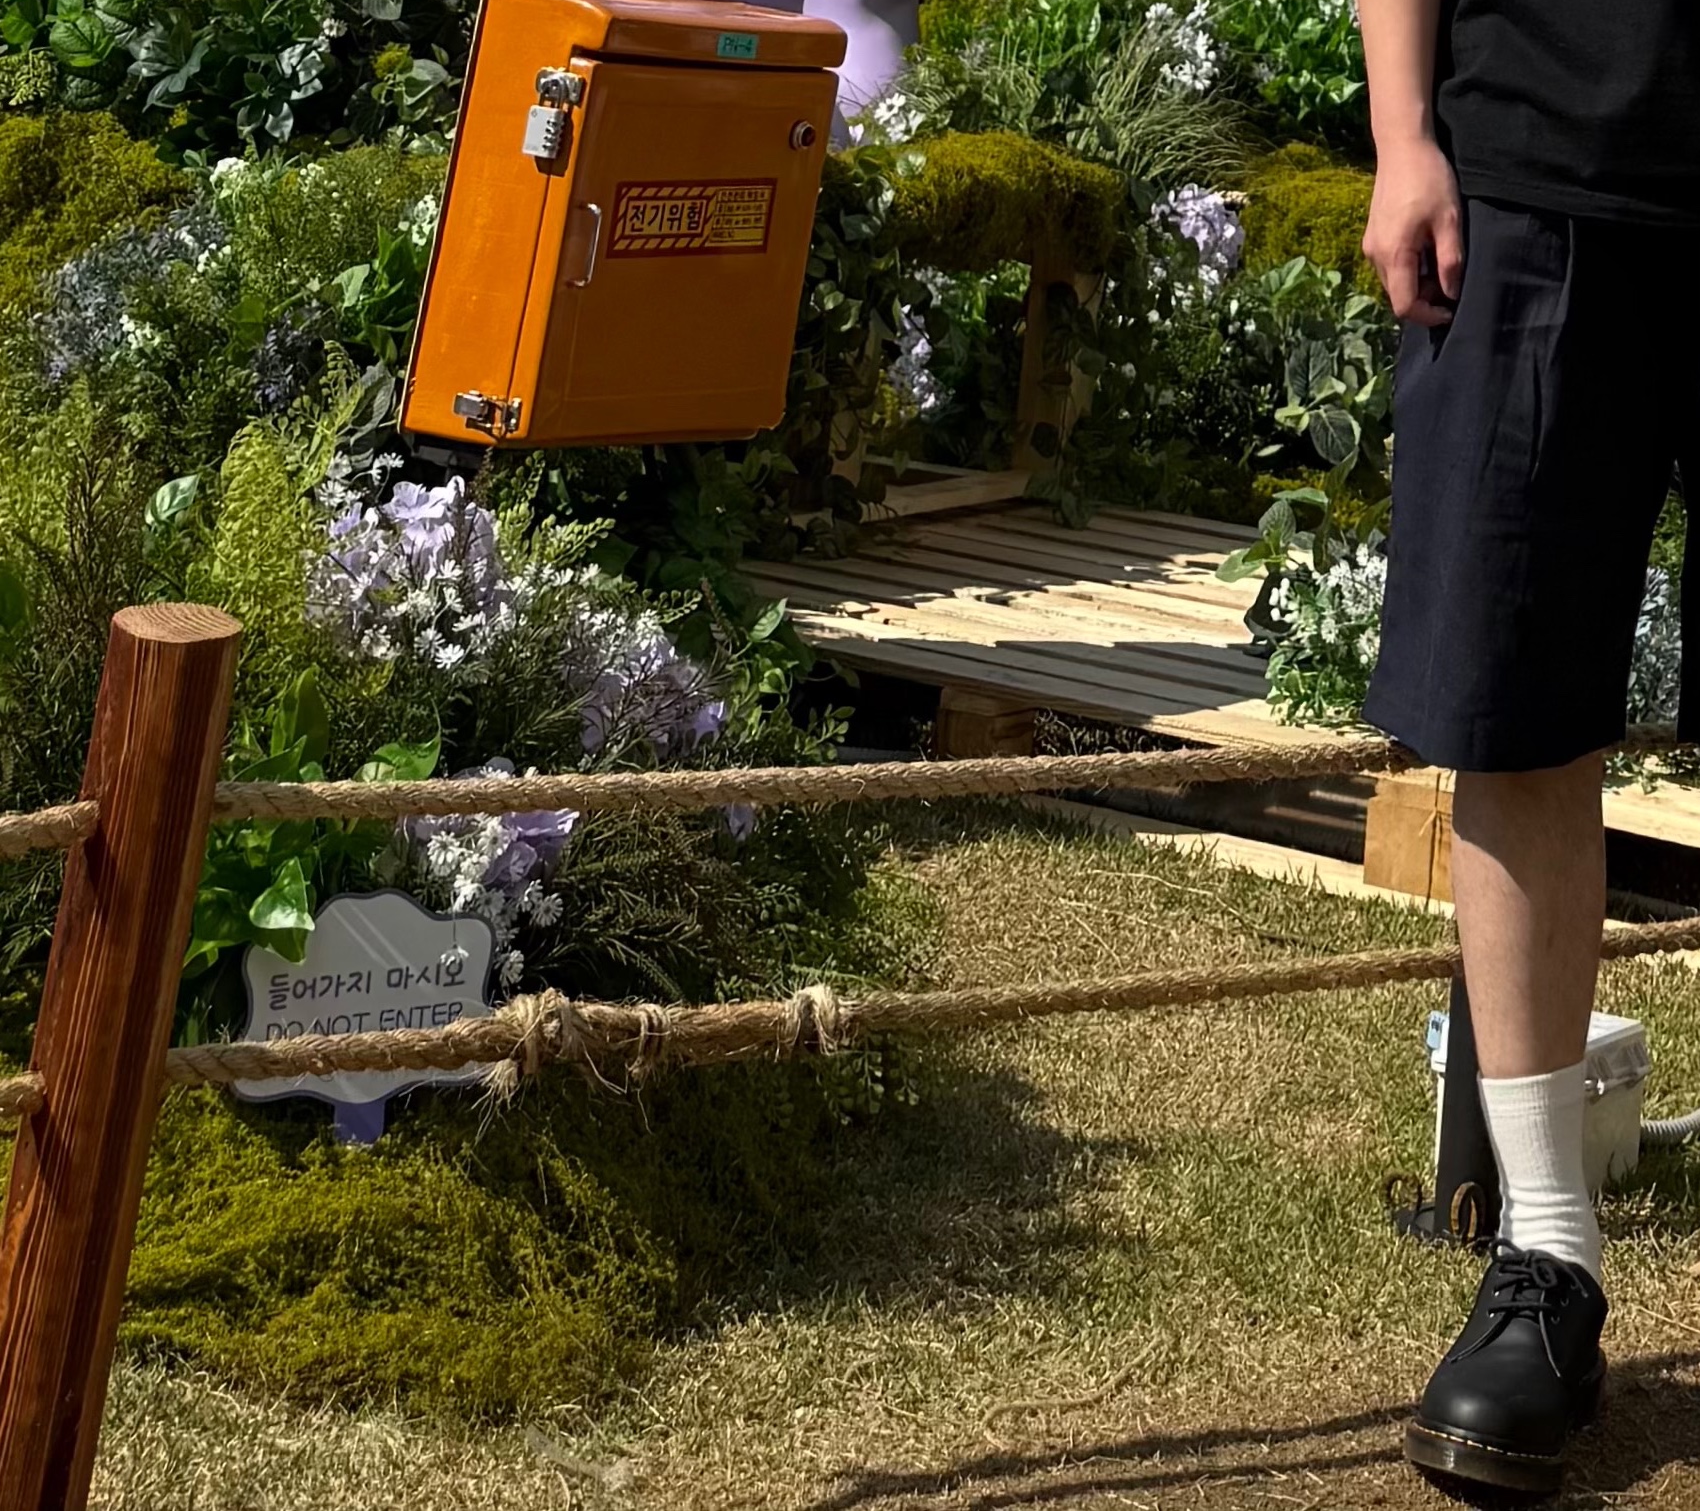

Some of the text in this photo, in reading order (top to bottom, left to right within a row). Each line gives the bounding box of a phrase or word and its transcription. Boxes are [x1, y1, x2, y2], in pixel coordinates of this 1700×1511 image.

[629, 201, 703, 233] 전기위험
[268, 960, 466, 1011] 들어가지 마시오
[265, 1001, 464, 1041] DO NOT ENTER
